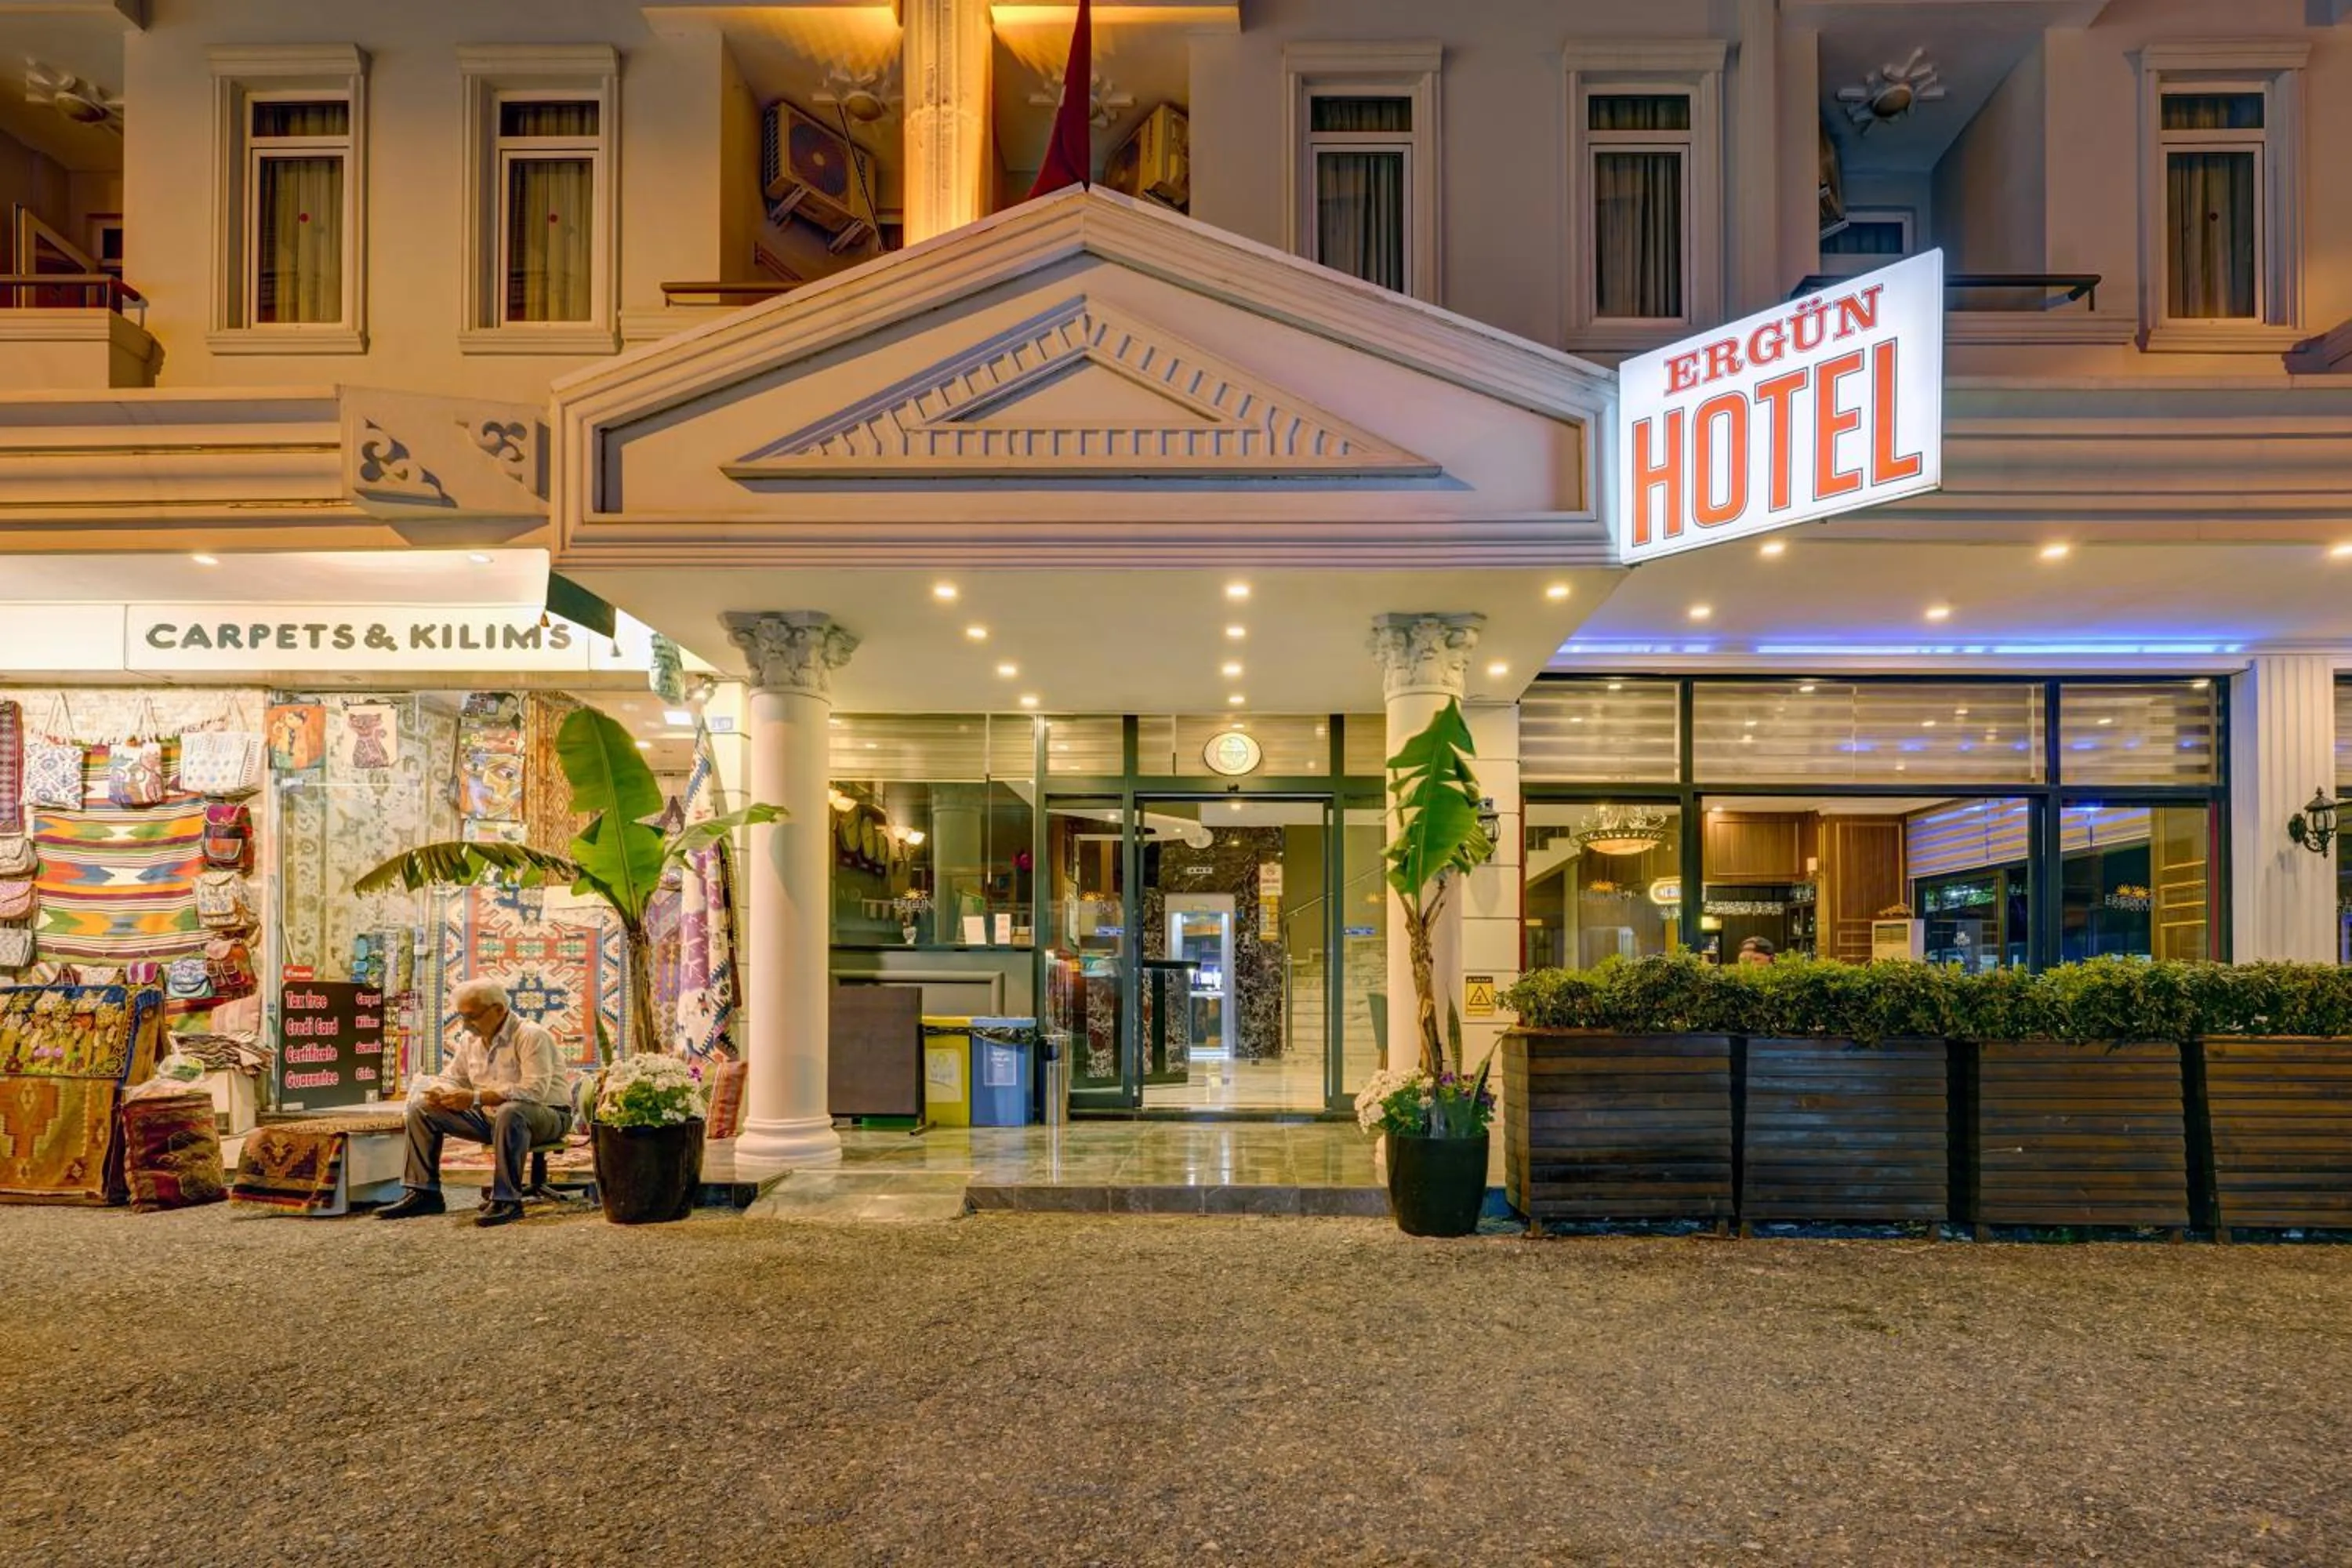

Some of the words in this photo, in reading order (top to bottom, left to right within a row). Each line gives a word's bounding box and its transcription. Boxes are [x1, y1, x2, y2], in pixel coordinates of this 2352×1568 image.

[1664, 284, 1883, 396] ERGÜN
[1632, 337, 1922, 547] HOTEL
[410, 623, 572, 650] KILIMS
[286, 991, 304, 1008] Tax
[315, 1017, 338, 1035] Card
[285, 1044, 337, 1062] Certificate
